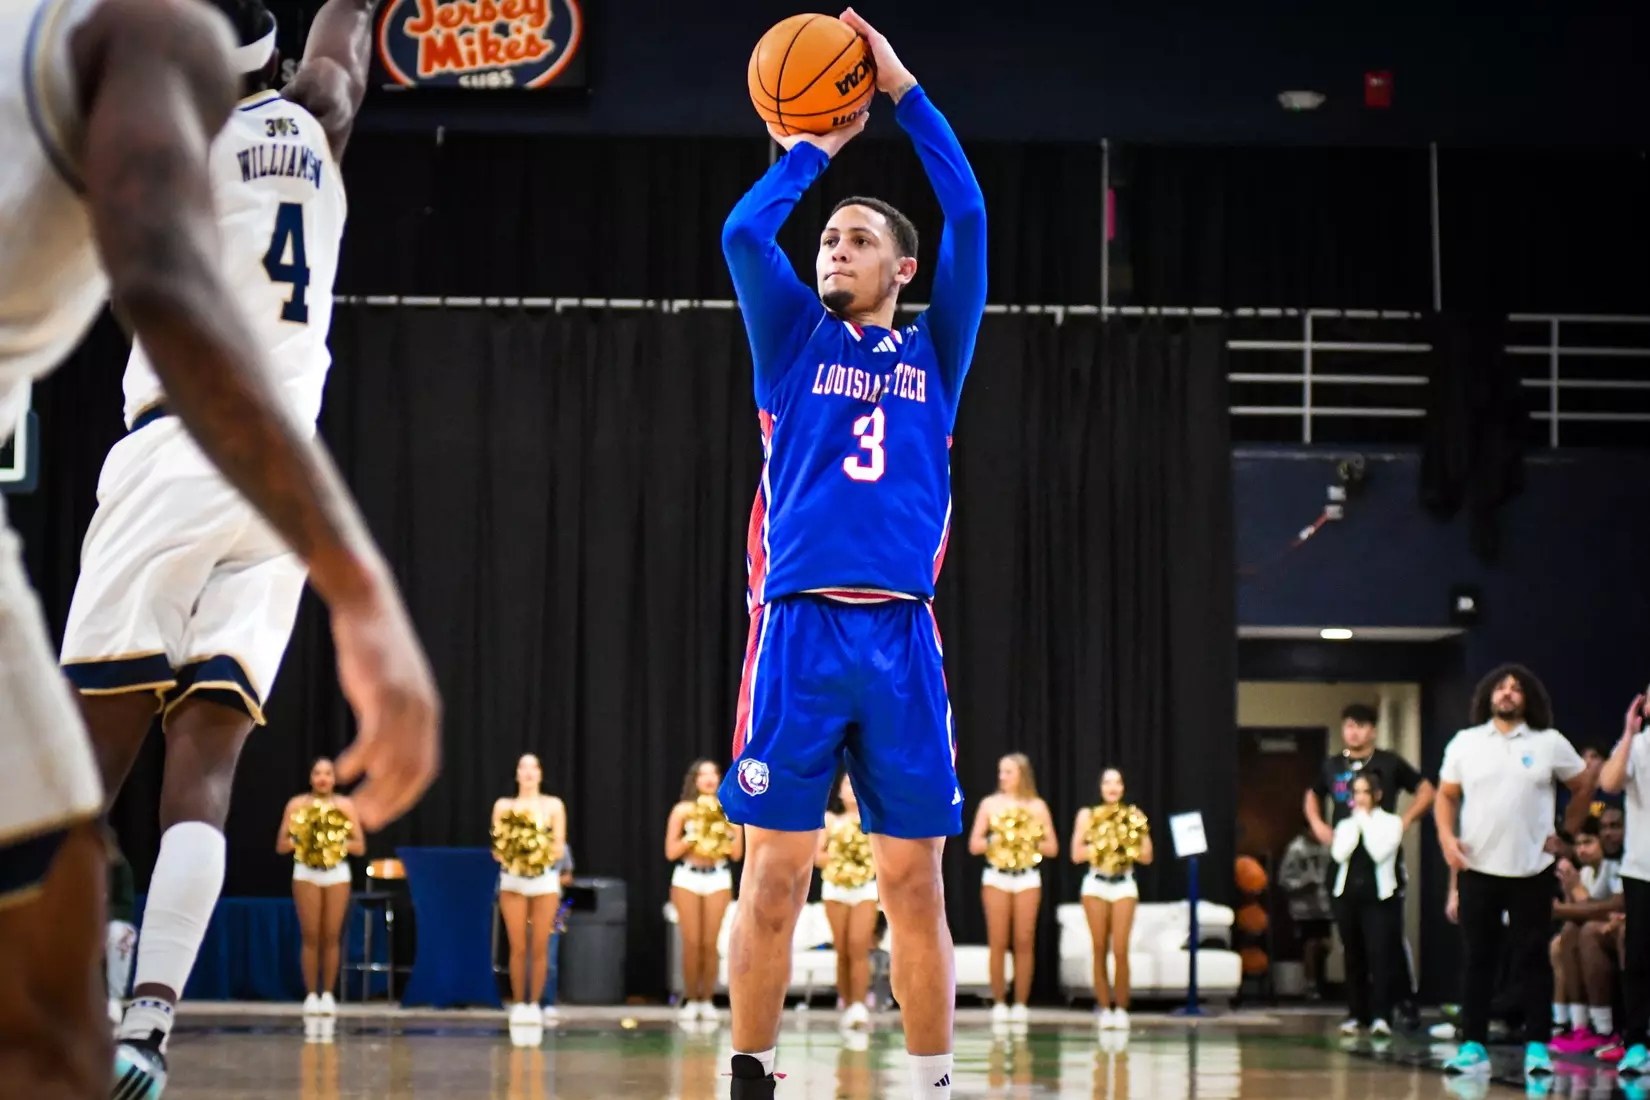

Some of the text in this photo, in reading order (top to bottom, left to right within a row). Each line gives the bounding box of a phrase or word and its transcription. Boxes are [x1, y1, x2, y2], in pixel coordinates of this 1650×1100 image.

[405, 0, 550, 36] Jersey
[418, 24, 555, 77] Mike's
[262, 201, 311, 324] 4
[811, 362, 926, 403] LOUISIA TECH
[842, 405, 887, 482] 3
